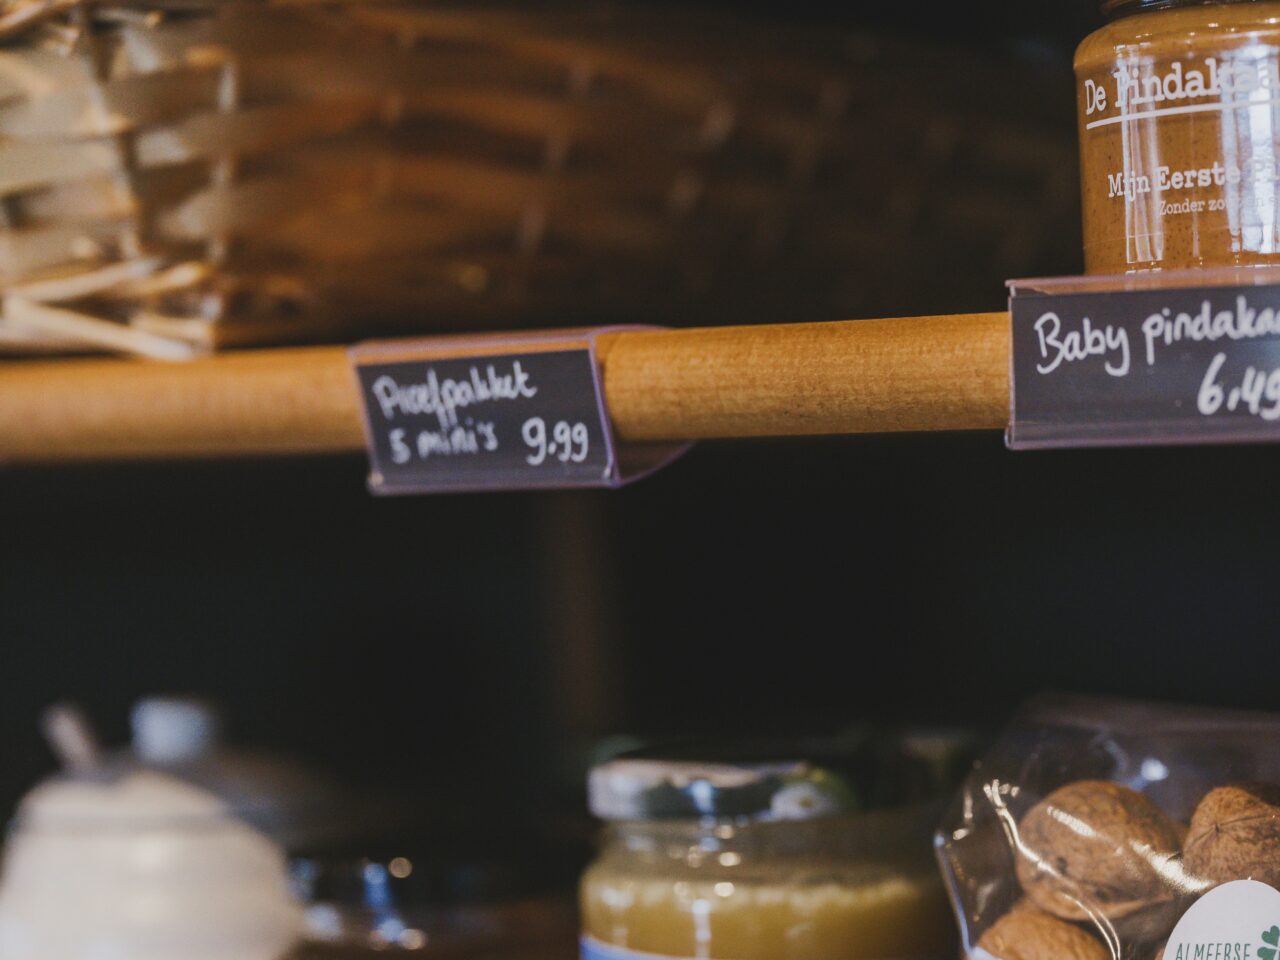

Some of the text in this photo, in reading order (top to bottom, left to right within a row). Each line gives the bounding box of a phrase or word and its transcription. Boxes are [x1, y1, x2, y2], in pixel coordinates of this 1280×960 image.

[1085, 79, 1107, 115] De
[1108, 169, 1150, 202] Mijn
[1151, 161, 1240, 191] Eerste
[1159, 198, 1206, 216] Zonder
[1034, 311, 1130, 376] Baby
